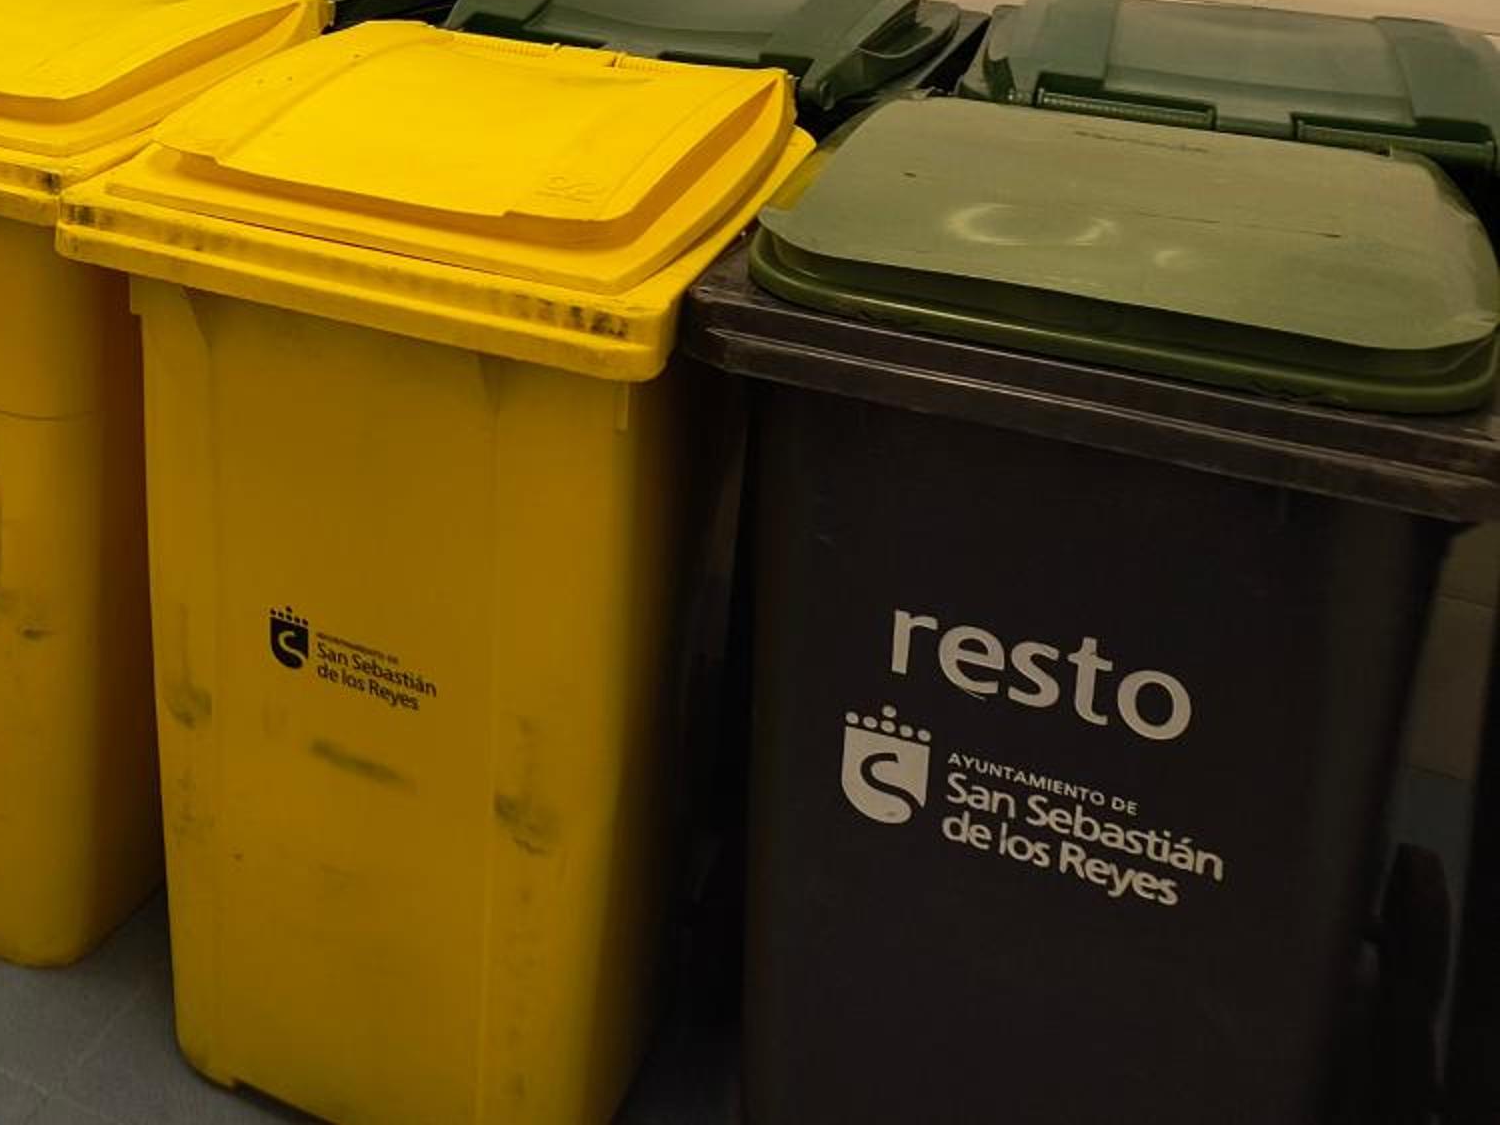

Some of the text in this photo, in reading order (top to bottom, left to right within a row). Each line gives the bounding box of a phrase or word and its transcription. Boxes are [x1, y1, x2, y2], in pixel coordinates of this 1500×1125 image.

[316, 642, 349, 667] San
[352, 653, 437, 698] Sebastián
[316, 662, 420, 711] de los Reyes
[891, 609, 1192, 741] resto
[947, 752, 1139, 817] AYUNTAMIENTO DE
[941, 810, 1179, 906] de los Reyes
[946, 771, 1224, 882] San Sebastián
